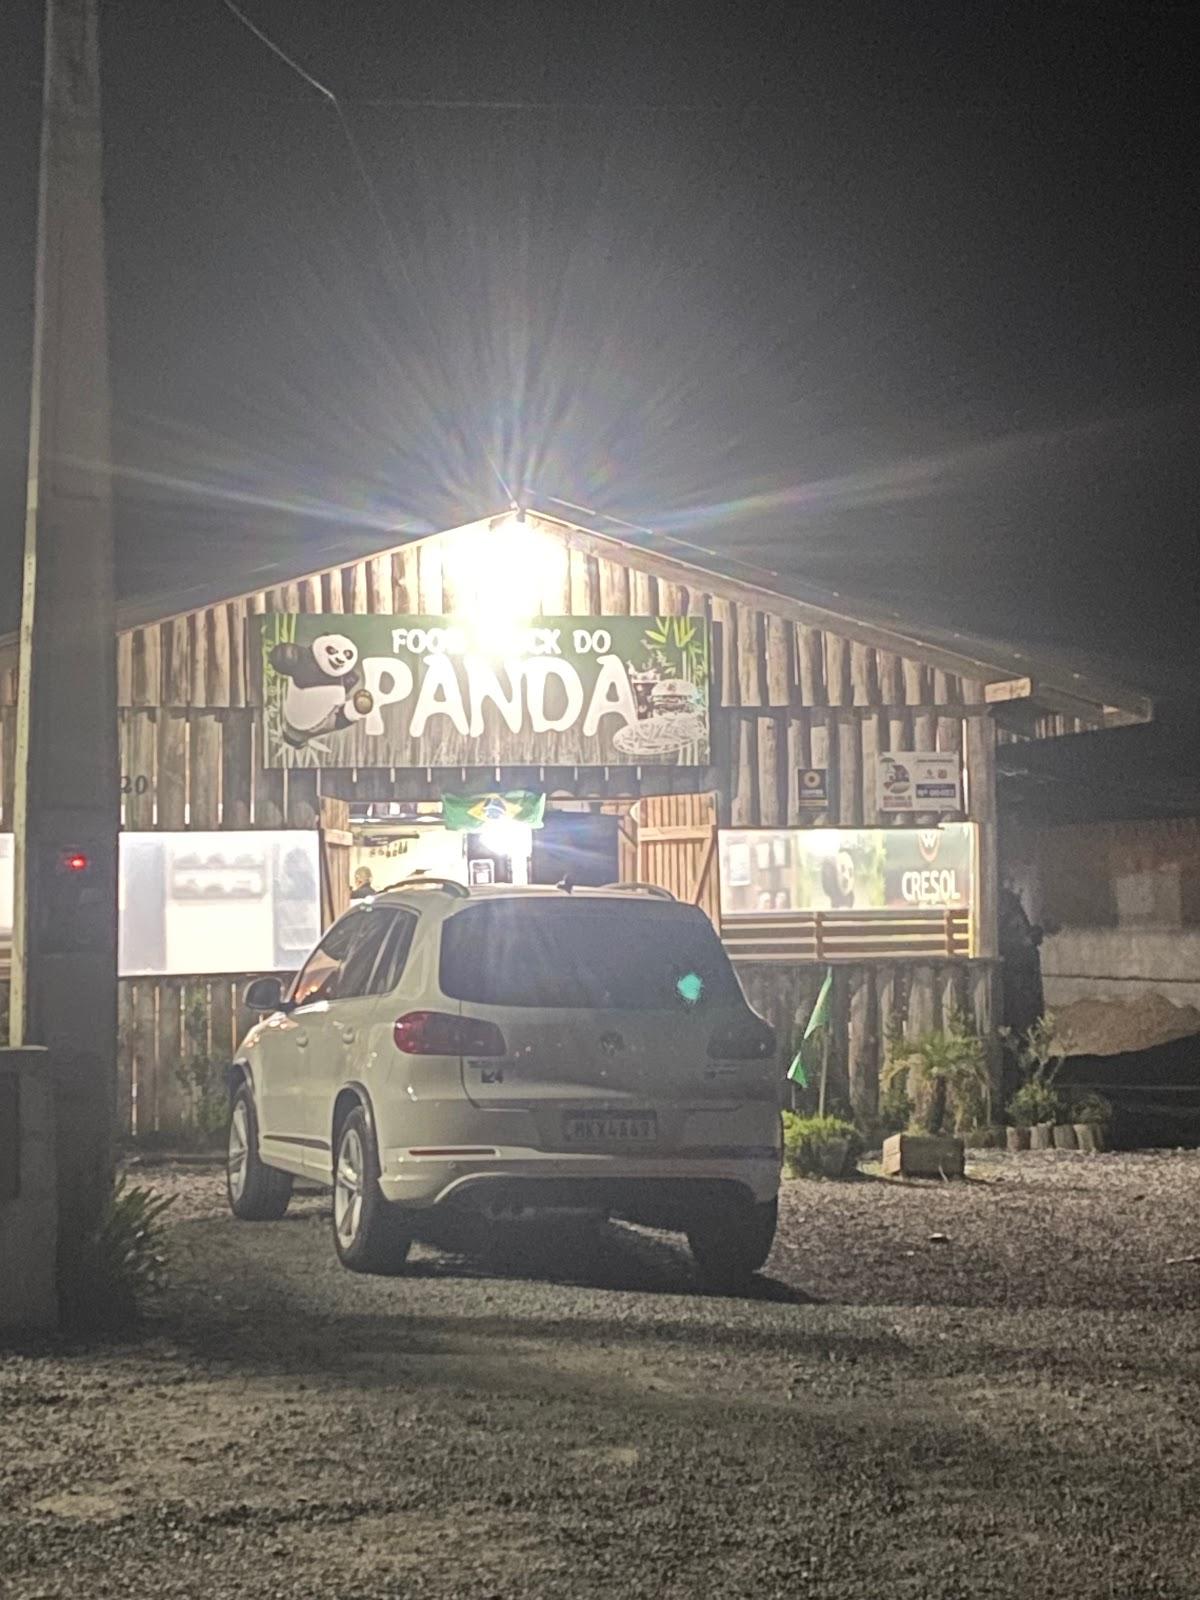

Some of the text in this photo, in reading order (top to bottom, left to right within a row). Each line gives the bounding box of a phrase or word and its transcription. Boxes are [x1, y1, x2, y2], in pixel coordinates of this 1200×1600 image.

[573, 629, 612, 654] DO
[362, 653, 638, 738] PANDA
[901, 869, 961, 902] CRESOL
